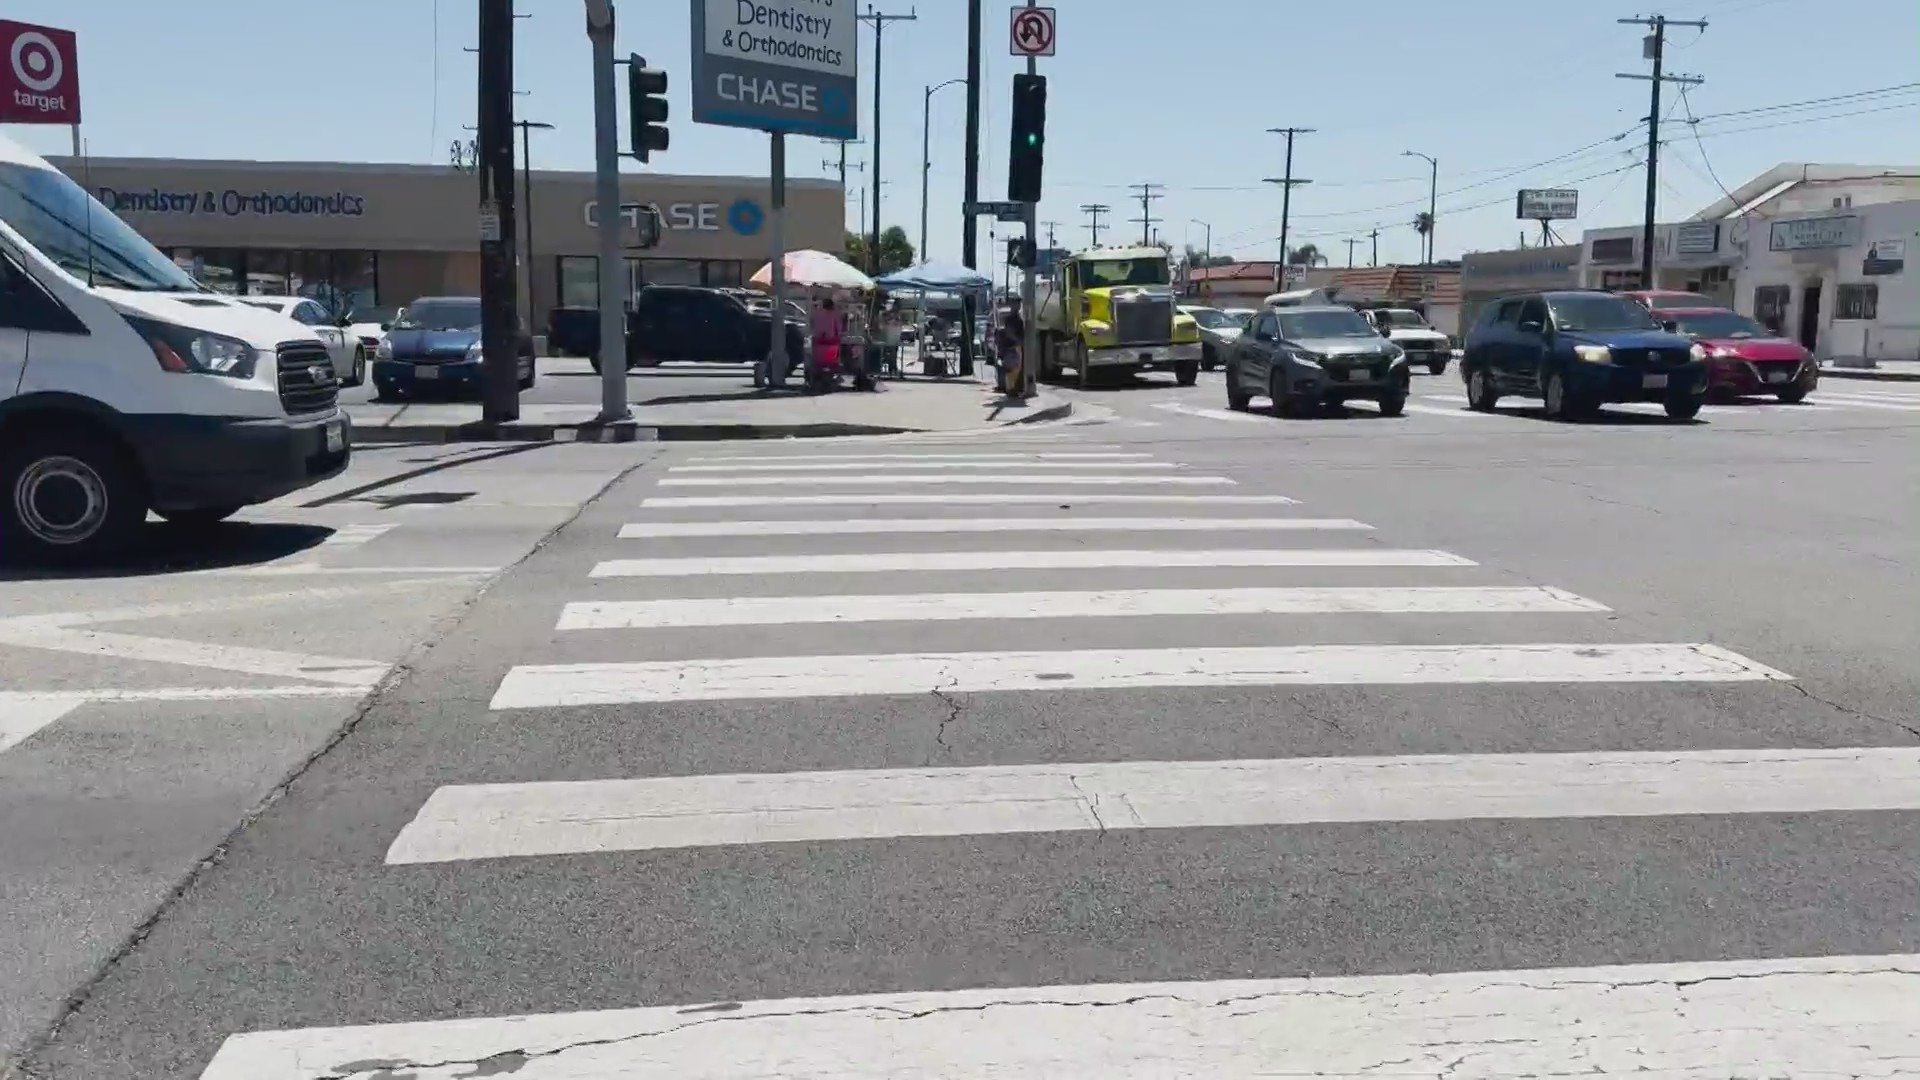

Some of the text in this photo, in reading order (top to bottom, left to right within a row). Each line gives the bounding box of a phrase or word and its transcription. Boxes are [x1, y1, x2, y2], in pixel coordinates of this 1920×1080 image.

[736, 0, 832, 39] Dentistry
[722, 29, 842, 66] & Orthodontics
[14, 89, 67, 112] target
[717, 73, 818, 112] CHASE
[203, 191, 217, 213] &
[222, 189, 364, 216] Orthodontics
